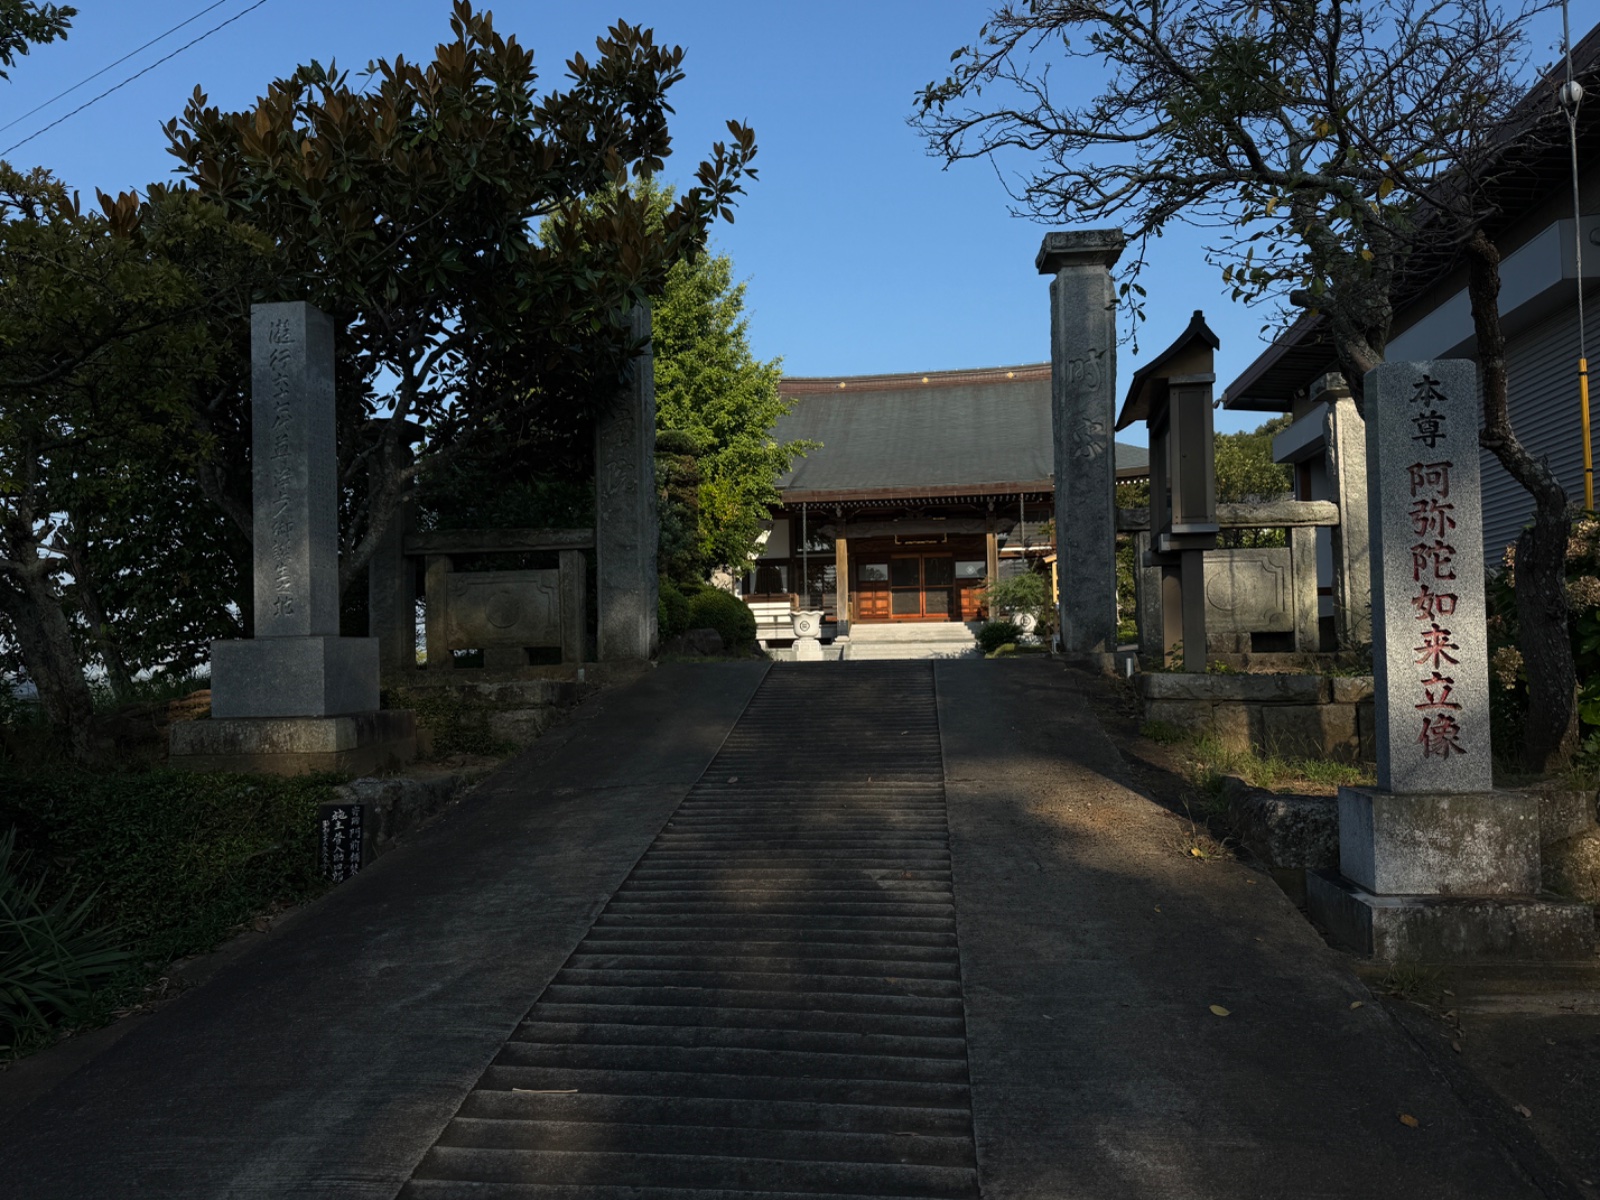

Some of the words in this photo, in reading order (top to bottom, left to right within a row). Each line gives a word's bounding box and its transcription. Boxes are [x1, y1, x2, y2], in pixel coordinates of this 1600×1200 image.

[1409, 374, 1448, 449] 本尊
[1407, 461, 1468, 762] 阿弥陀如来立像
